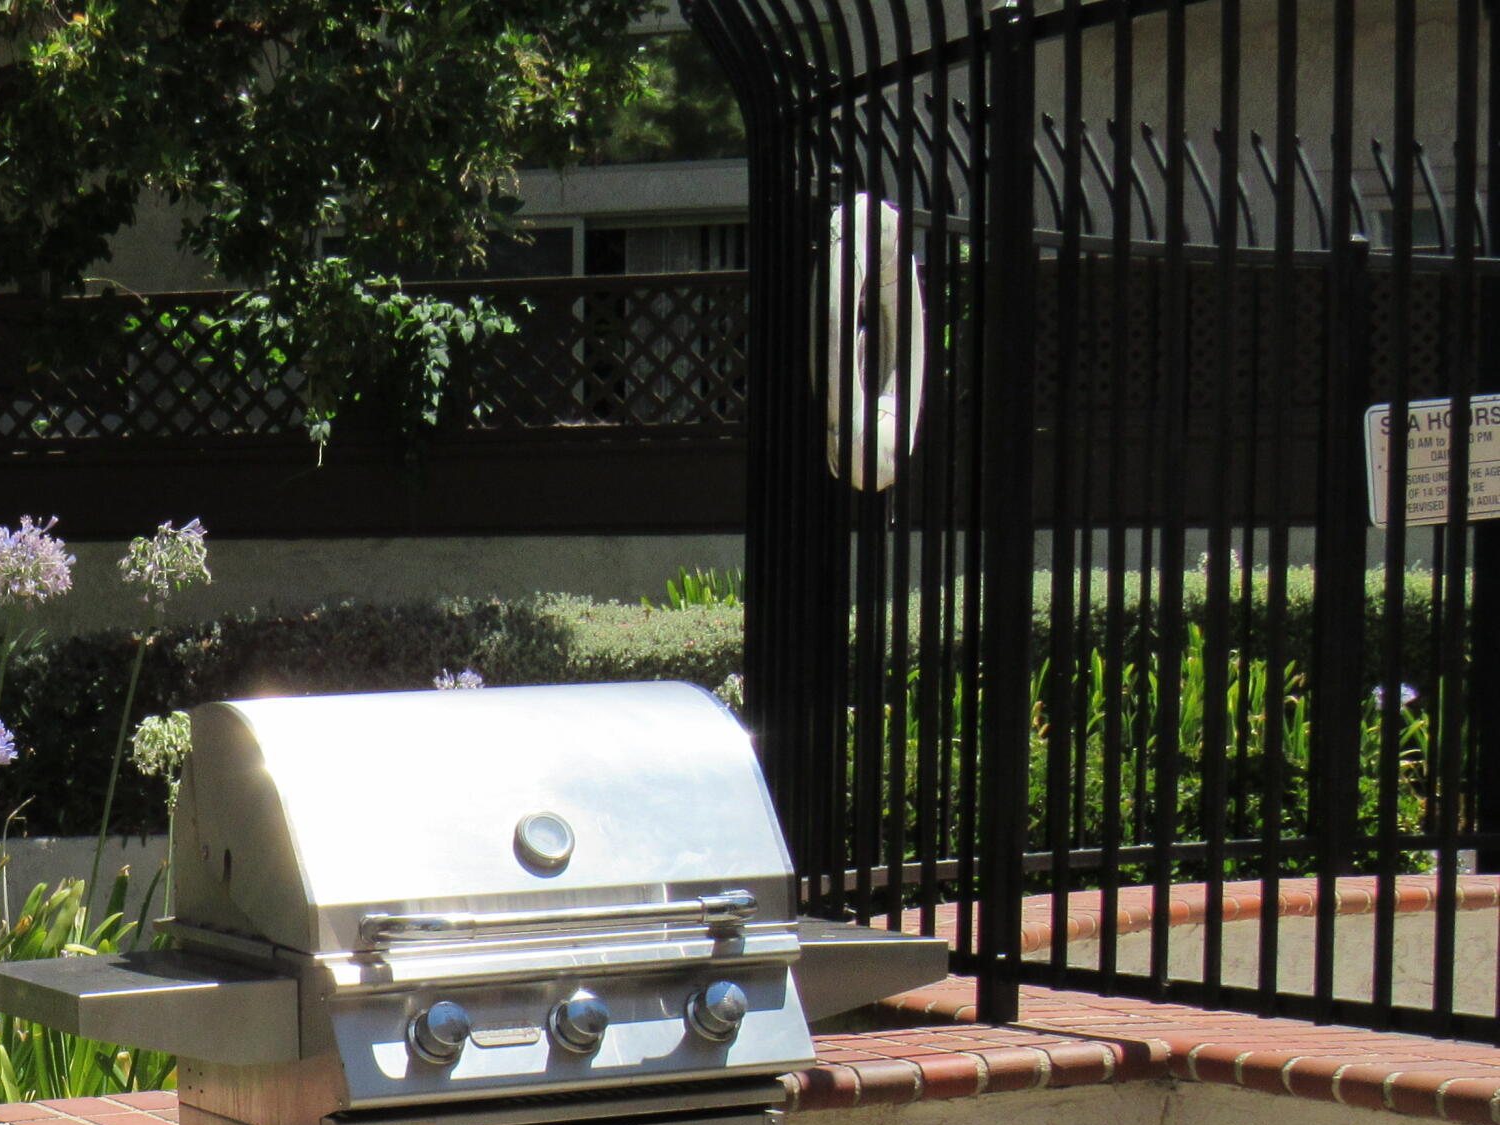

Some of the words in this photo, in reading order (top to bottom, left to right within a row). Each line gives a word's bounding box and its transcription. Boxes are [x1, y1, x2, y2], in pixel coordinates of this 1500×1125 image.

[1381, 413, 1421, 435] SA
[1427, 406, 1500, 431] HORS
[1477, 431, 1493, 443] PM
